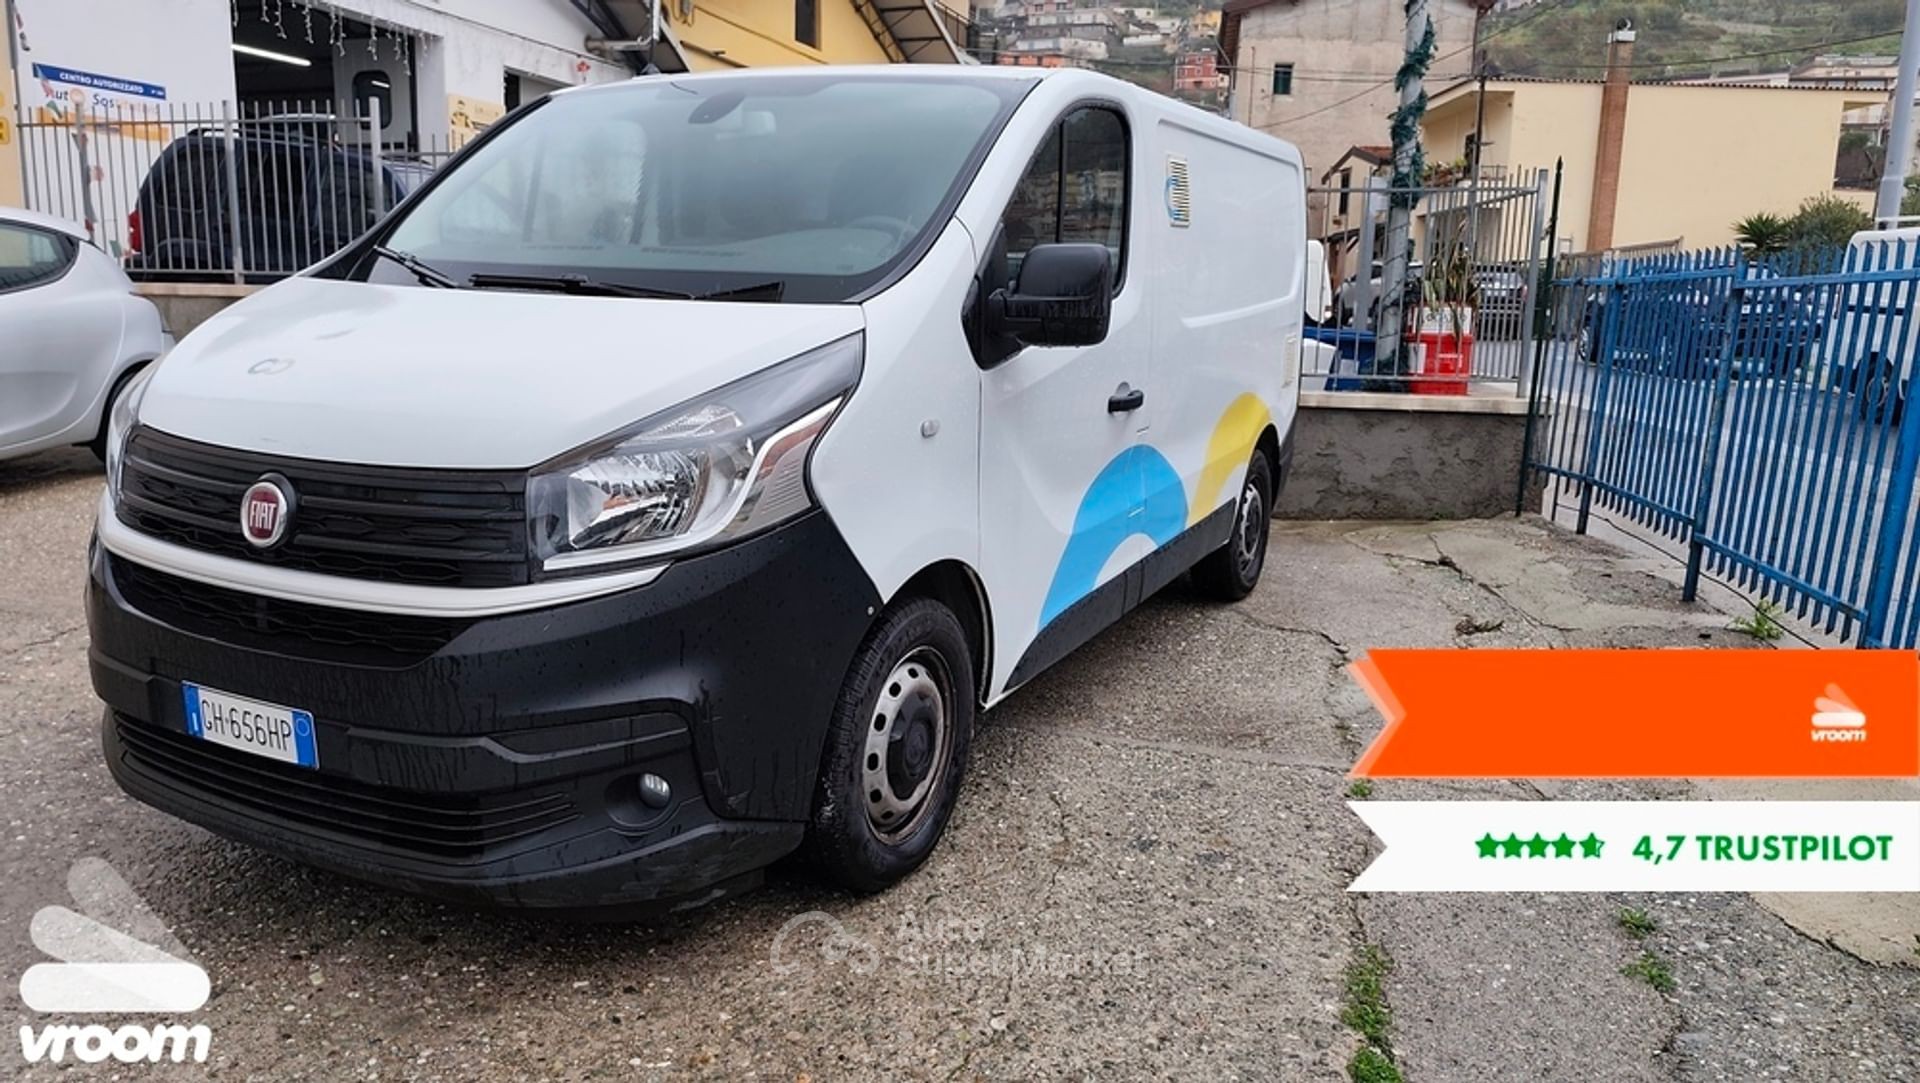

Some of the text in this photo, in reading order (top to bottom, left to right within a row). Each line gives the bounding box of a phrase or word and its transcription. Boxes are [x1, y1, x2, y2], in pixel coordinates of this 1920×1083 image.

[59, 72, 92, 85] CENTRO
[92, 78, 144, 94] AUTORIZZATO
[250, 500, 277, 530] FIAT
